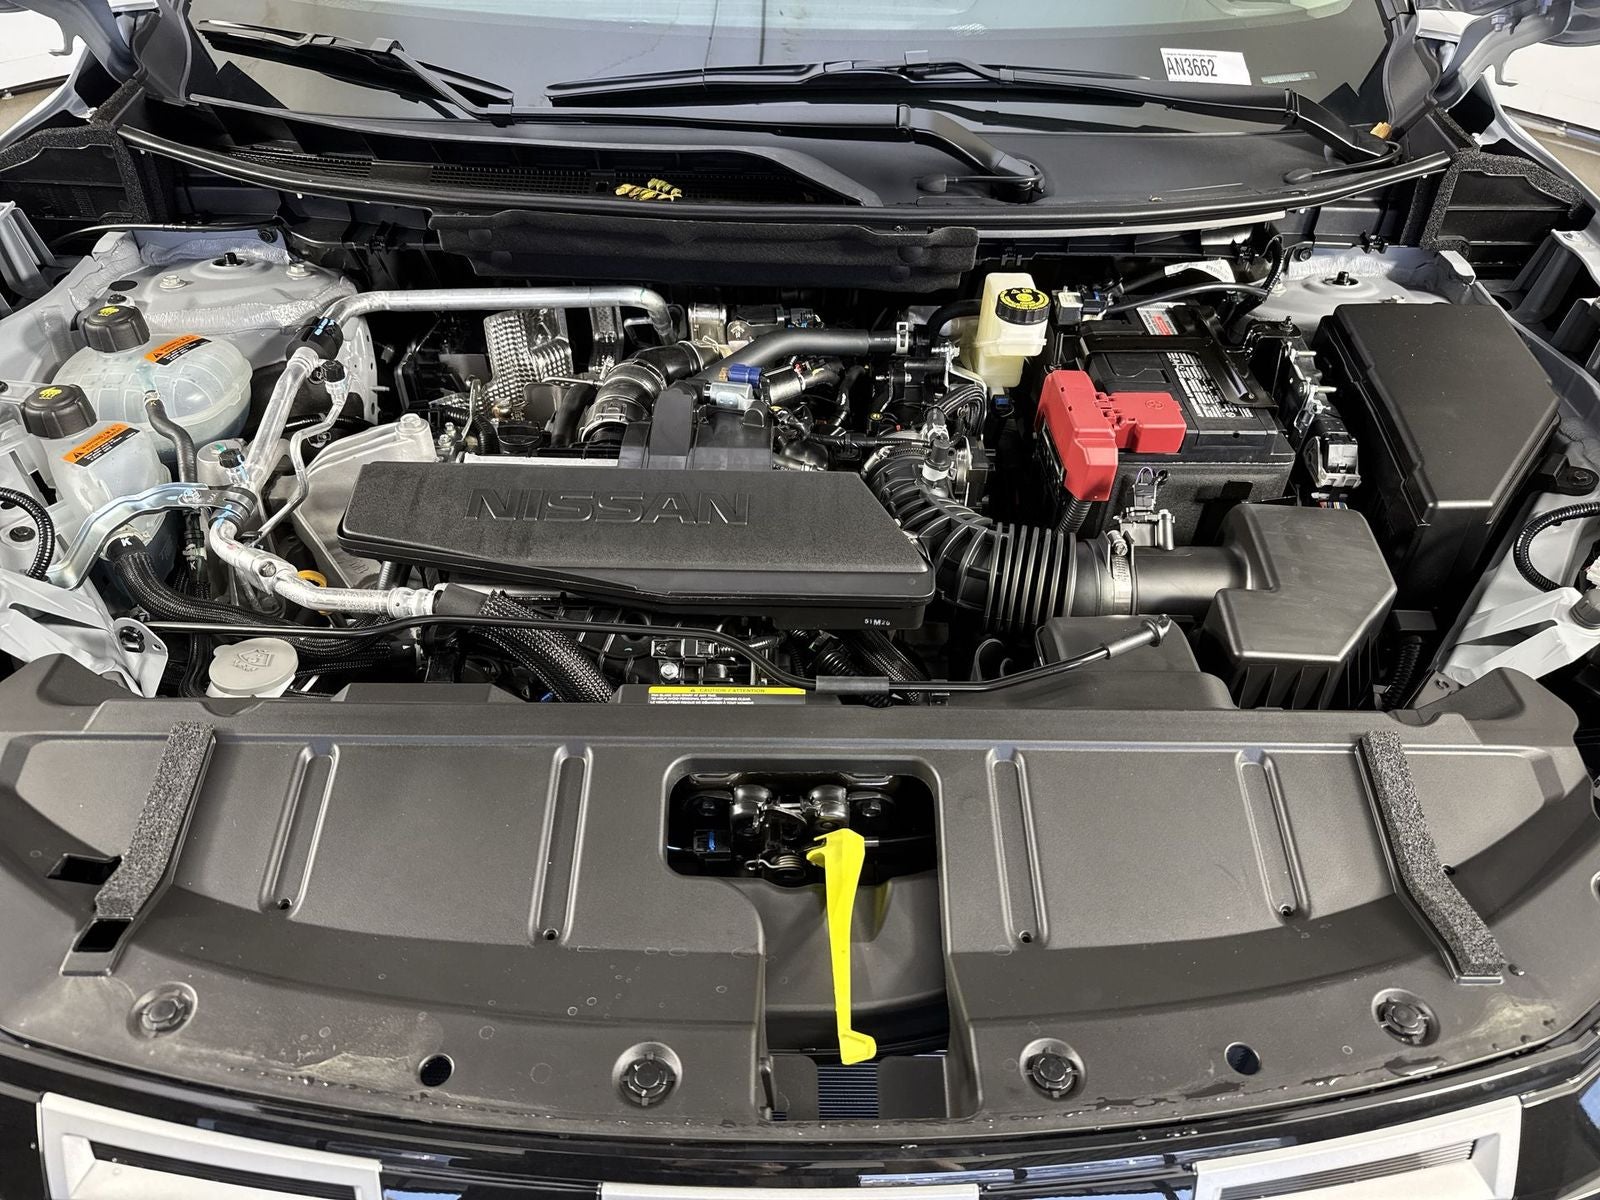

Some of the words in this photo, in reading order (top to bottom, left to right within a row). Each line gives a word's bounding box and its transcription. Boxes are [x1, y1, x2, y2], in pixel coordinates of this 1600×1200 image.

[1166, 57, 1218, 77] AN3662
[464, 488, 750, 525] NISSAN
[120, 537, 133, 547] K
